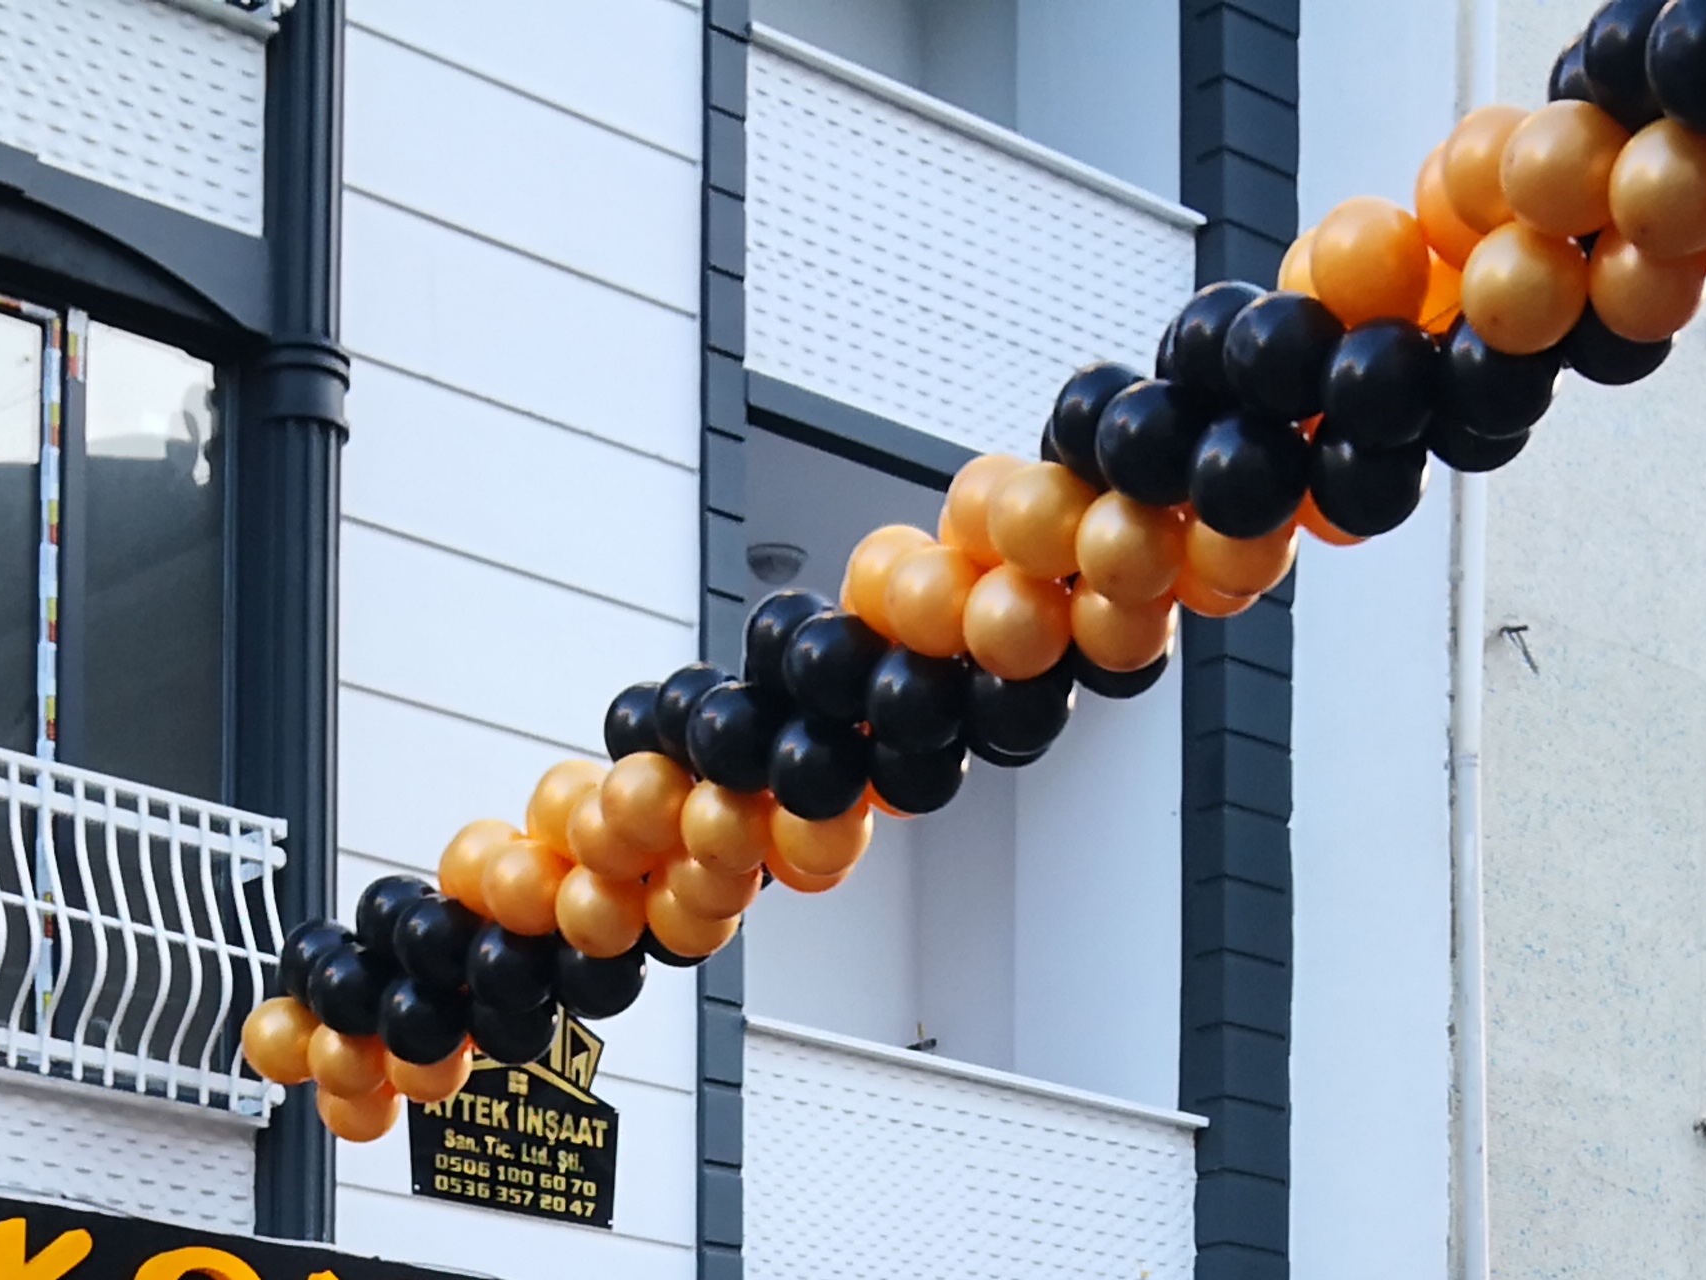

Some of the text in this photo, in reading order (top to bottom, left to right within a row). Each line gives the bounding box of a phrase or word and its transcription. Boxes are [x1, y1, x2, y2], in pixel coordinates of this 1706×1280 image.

[517, 1097, 608, 1148] İNŞAAT
[444, 1128, 480, 1154] San.
[484, 1135, 515, 1161] Tic.
[521, 1142, 553, 1167] Ltd.
[434, 1174, 596, 1217] 0536 357 20 47
[497, 1165, 534, 1187] 100
[570, 1179, 597, 1197] 70
